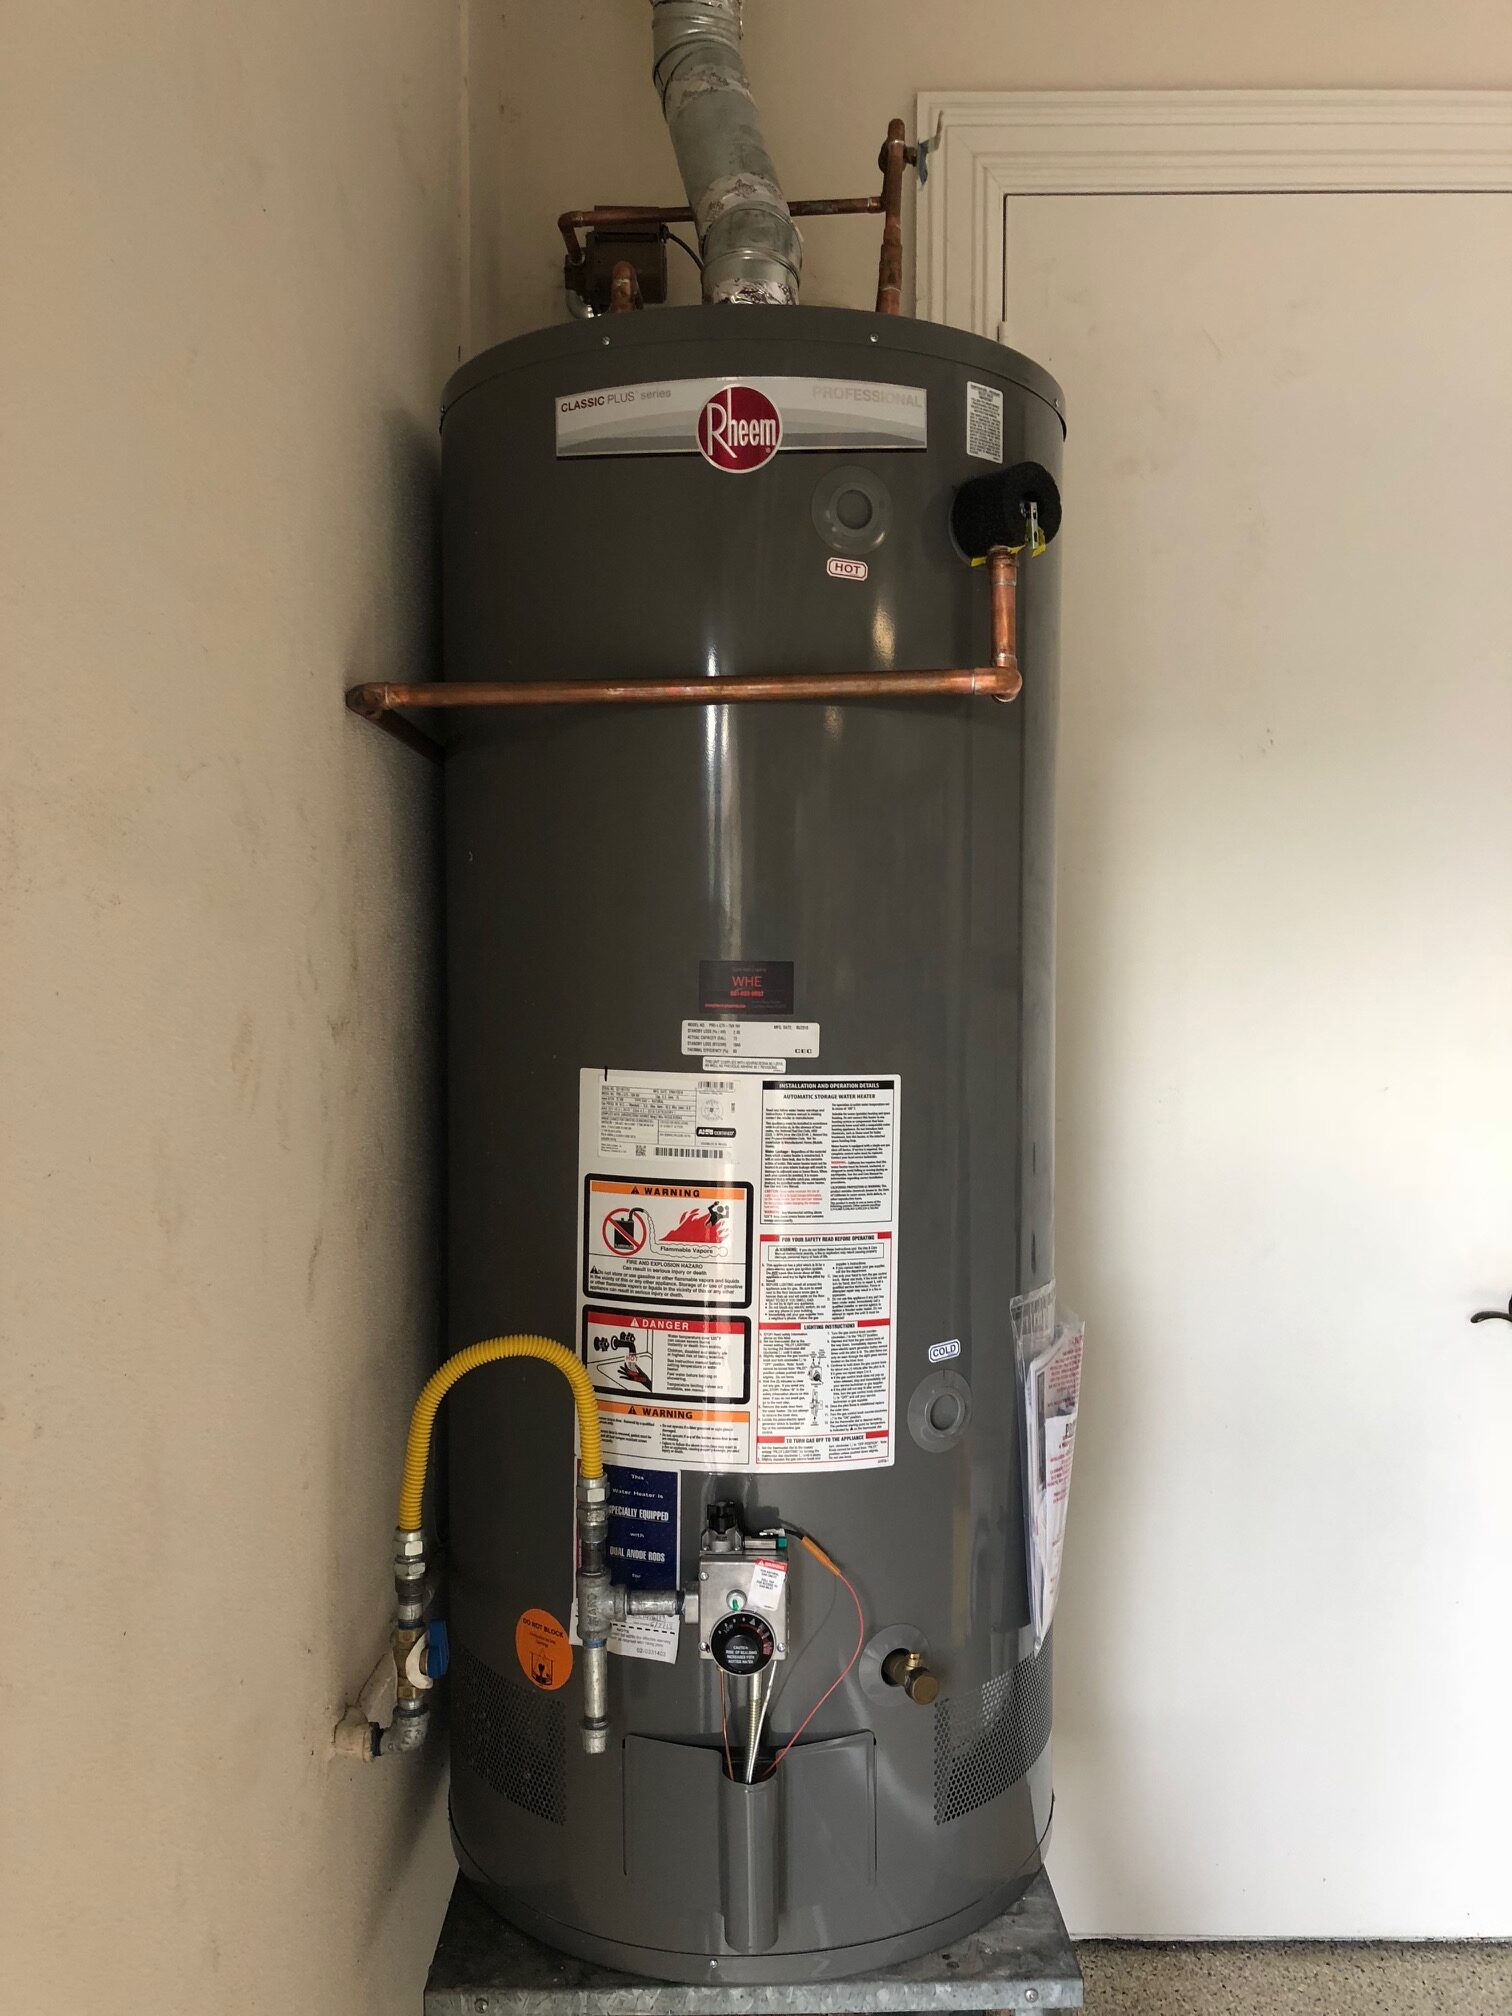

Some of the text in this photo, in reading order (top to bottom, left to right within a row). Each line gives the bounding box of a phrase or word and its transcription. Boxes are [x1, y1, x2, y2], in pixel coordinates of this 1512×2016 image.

[561, 389, 671, 412] CLASSIC PLUS series
[813, 385, 922, 408] PROFESSIONAL
[706, 387, 777, 458] Rheem
[835, 562, 861, 574] HOT
[732, 975, 762, 987] WHE
[644, 1187, 700, 1198] WARNING
[642, 1319, 689, 1330] DANGER
[933, 1344, 956, 1357] COLD
[642, 1408, 693, 1419] WARNING
[639, 1509, 669, 1521] EQUIPPED
[609, 1546, 665, 1562] DUAL ANODE RODS
[532, 1621, 542, 1629] NOT
[544, 1626, 563, 1638] BLOCK
